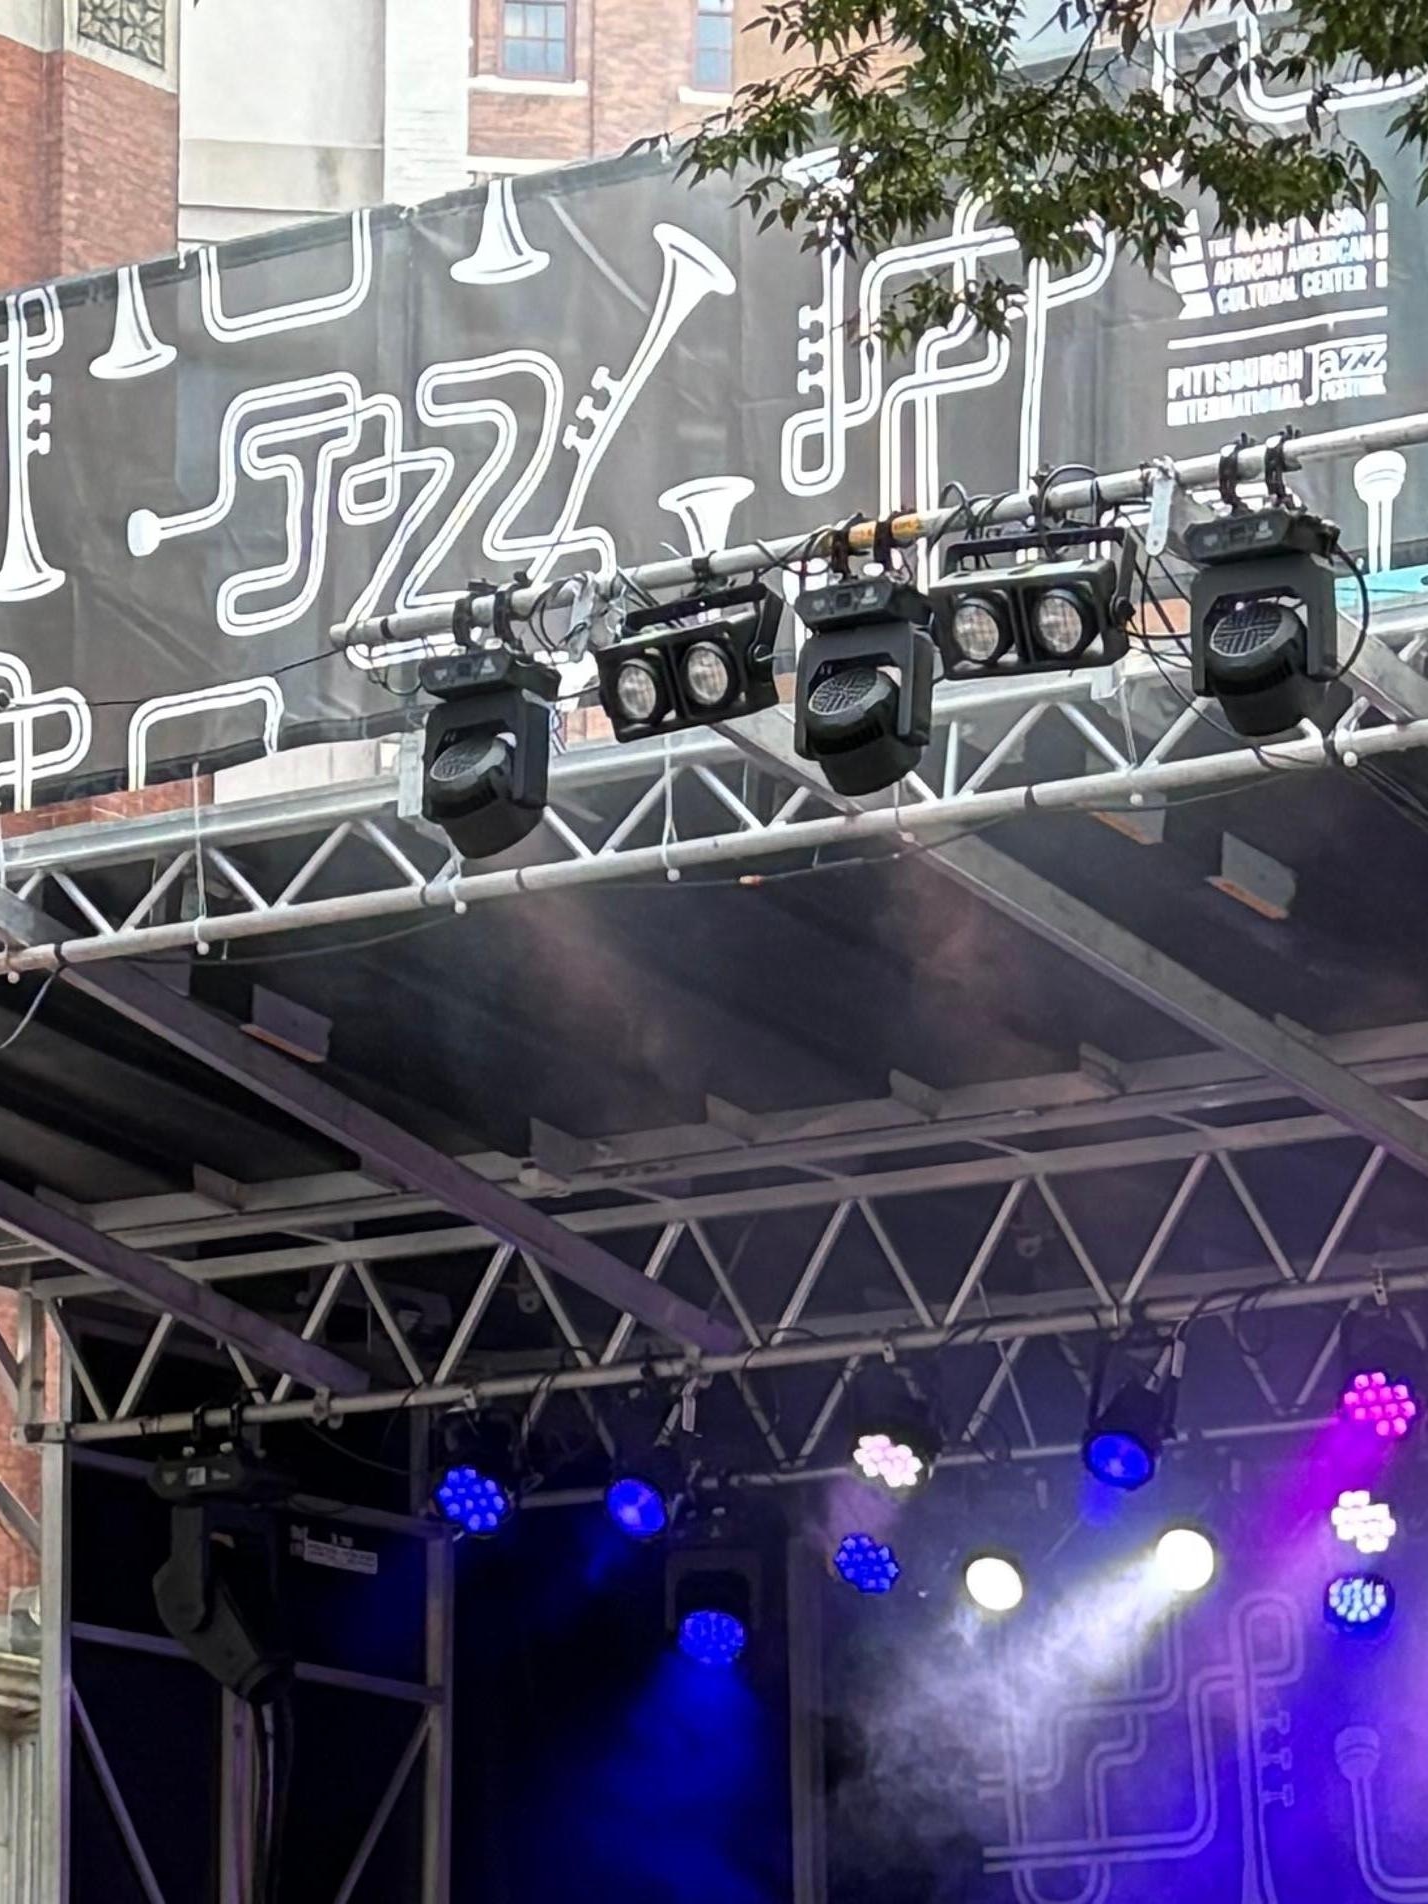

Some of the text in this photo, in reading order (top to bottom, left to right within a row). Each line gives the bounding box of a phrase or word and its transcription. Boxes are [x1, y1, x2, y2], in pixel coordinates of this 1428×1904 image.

[1213, 234, 1373, 286] AFRICAN AMERICAN
[1216, 265, 1367, 314] CULTURAL CENTER
[1168, 349, 1303, 399] PITTSBURGH
